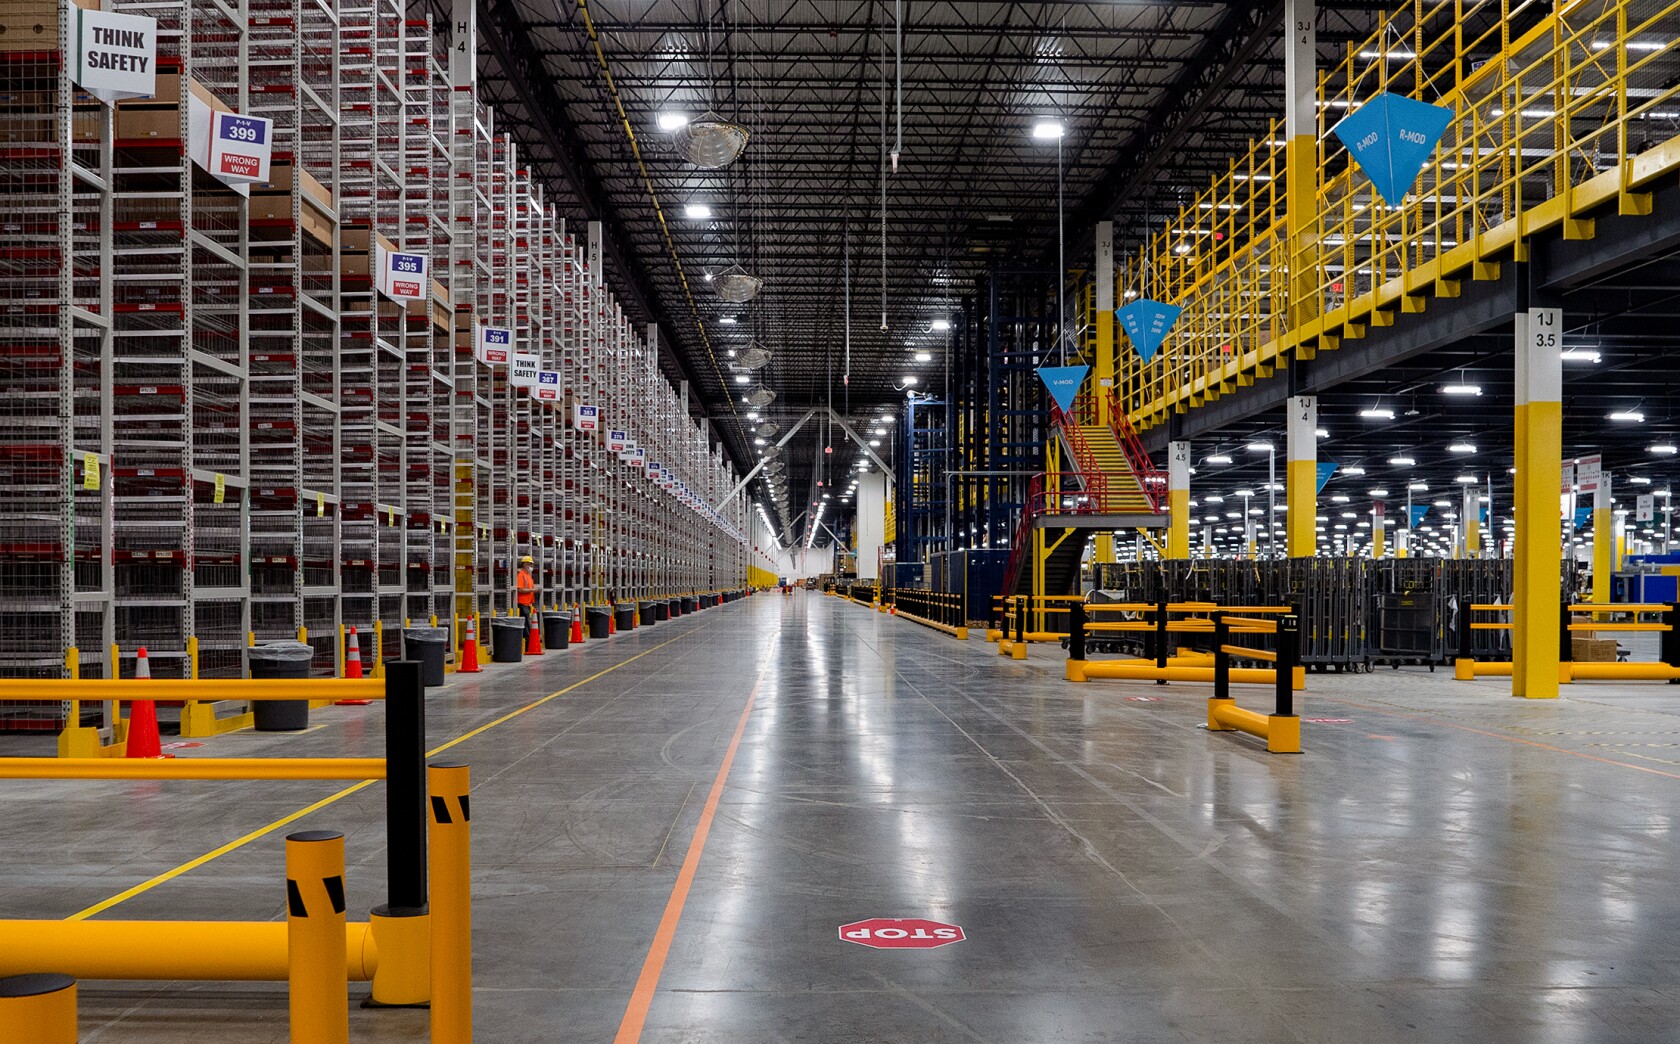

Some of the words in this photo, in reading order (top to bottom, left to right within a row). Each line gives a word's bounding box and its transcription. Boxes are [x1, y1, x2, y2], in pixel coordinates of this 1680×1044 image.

[457, 21, 467, 34] H
[1297, 21, 1311, 31] 3J
[92, 26, 145, 49] THINK
[1301, 36, 1307, 45] 4
[457, 41, 466, 53] 4
[88, 50, 149, 73] SAFETY
[229, 126, 256, 141] 399
[1399, 129, 1426, 145] R-MOD
[1356, 131, 1378, 152] R-MOD
[224, 155, 258, 166] WRONG
[231, 165, 250, 174] WAY
[591, 241, 597, 249] H
[591, 253, 597, 262] 5
[398, 261, 417, 272] 395
[395, 281, 419, 290] WRONG
[1537, 313, 1553, 326] 1J
[490, 335, 504, 343] 391
[1536, 334, 1555, 347] 3.5
[516, 360, 536, 368] THINK
[514, 369, 537, 378] SAFETY
[1299, 398, 1311, 408] 1J
[1302, 412, 1308, 421] 4
[846, 928, 957, 939] STOP
